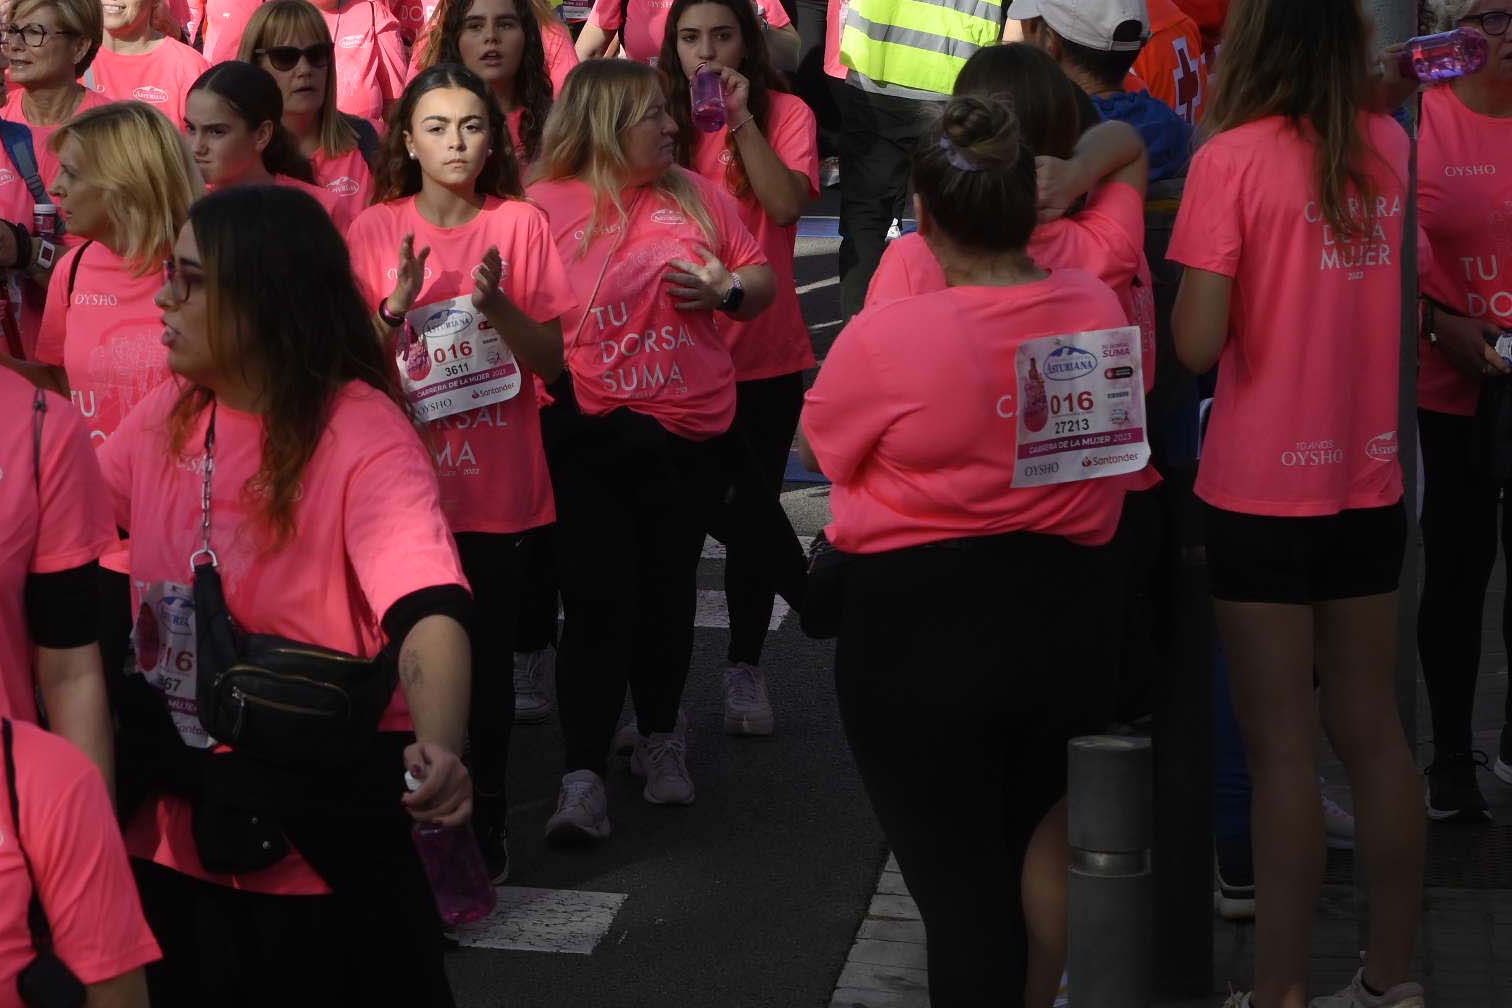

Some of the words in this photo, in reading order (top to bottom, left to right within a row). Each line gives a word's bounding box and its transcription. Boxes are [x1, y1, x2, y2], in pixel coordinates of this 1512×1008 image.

[1444, 165, 1496, 177] OYSHO
[1319, 243, 1393, 270] MUJER
[1458, 254, 1499, 282] TU
[589, 302, 630, 330] TU
[433, 340, 473, 364] 016
[1102, 348, 1131, 358] SUMA
[445, 363, 470, 378] 3611
[603, 361, 685, 393] SUMA
[1046, 361, 1094, 375] ASTURIANA
[416, 397, 453, 416] OYSHO
[478, 381, 515, 399] Santander
[1050, 391, 1095, 416] 016
[1055, 418, 1090, 435] 27213
[436, 439, 477, 467] MA
[1024, 462, 1059, 478] OYSHO
[1093, 452, 1139, 467] Santander
[1281, 448, 1344, 467] OYSHO
